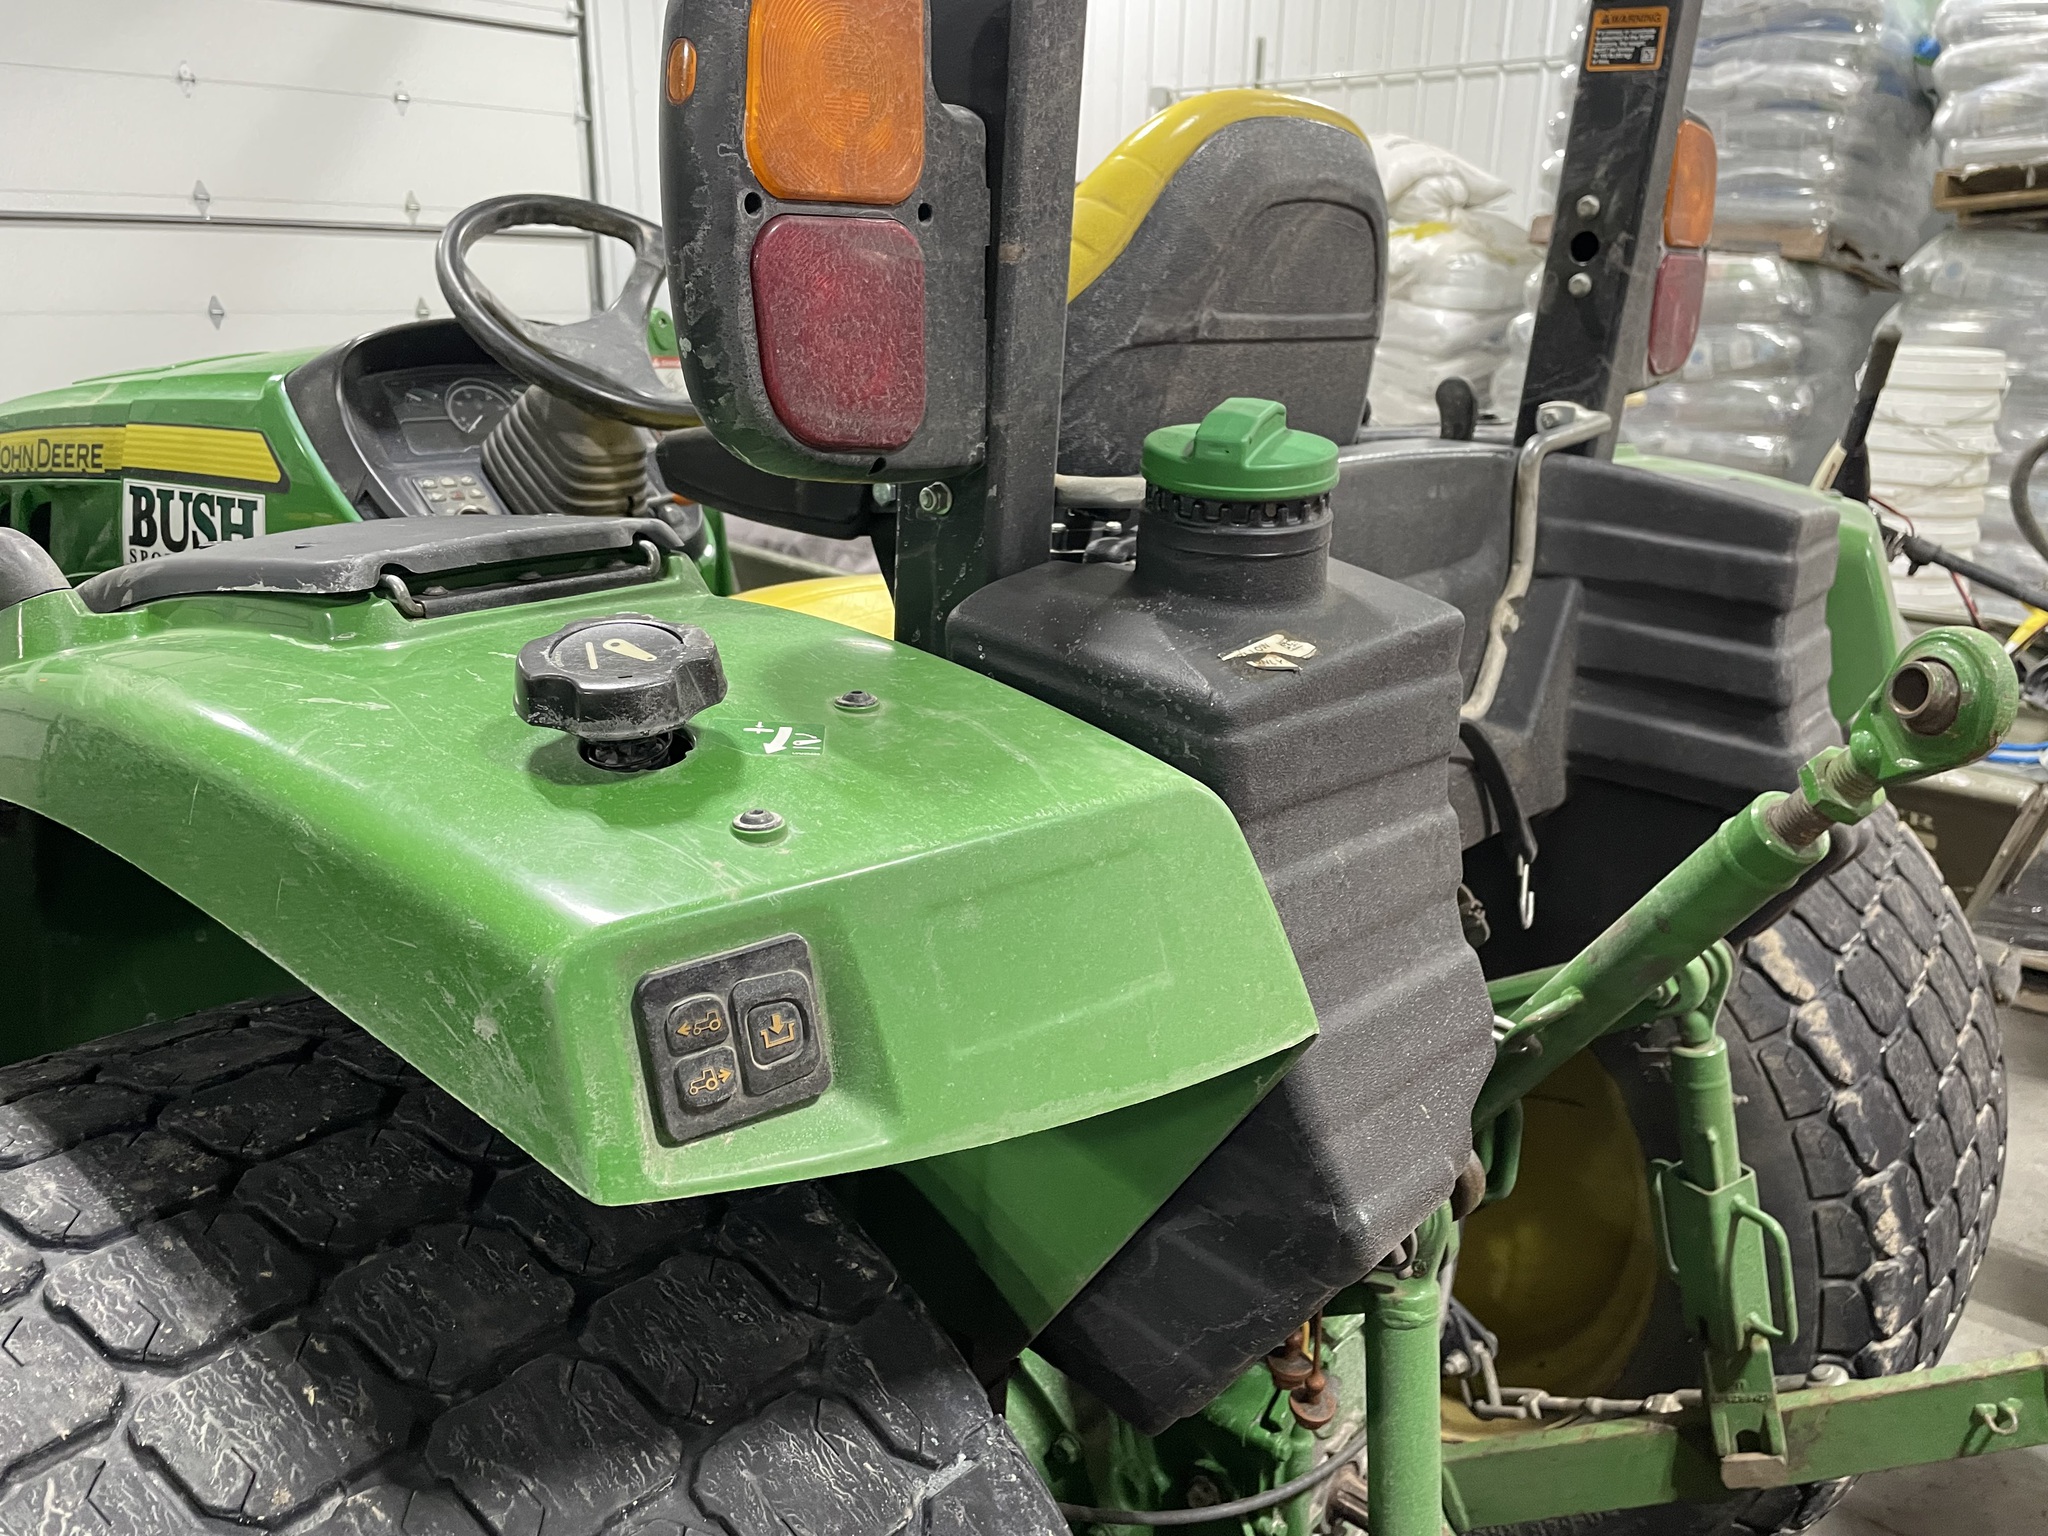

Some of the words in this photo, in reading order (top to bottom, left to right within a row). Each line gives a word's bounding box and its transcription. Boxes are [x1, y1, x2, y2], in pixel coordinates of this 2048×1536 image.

[0, 445, 34, 469] OHN
[37, 438, 104, 469] DEERE
[129, 485, 258, 553] BUSH
